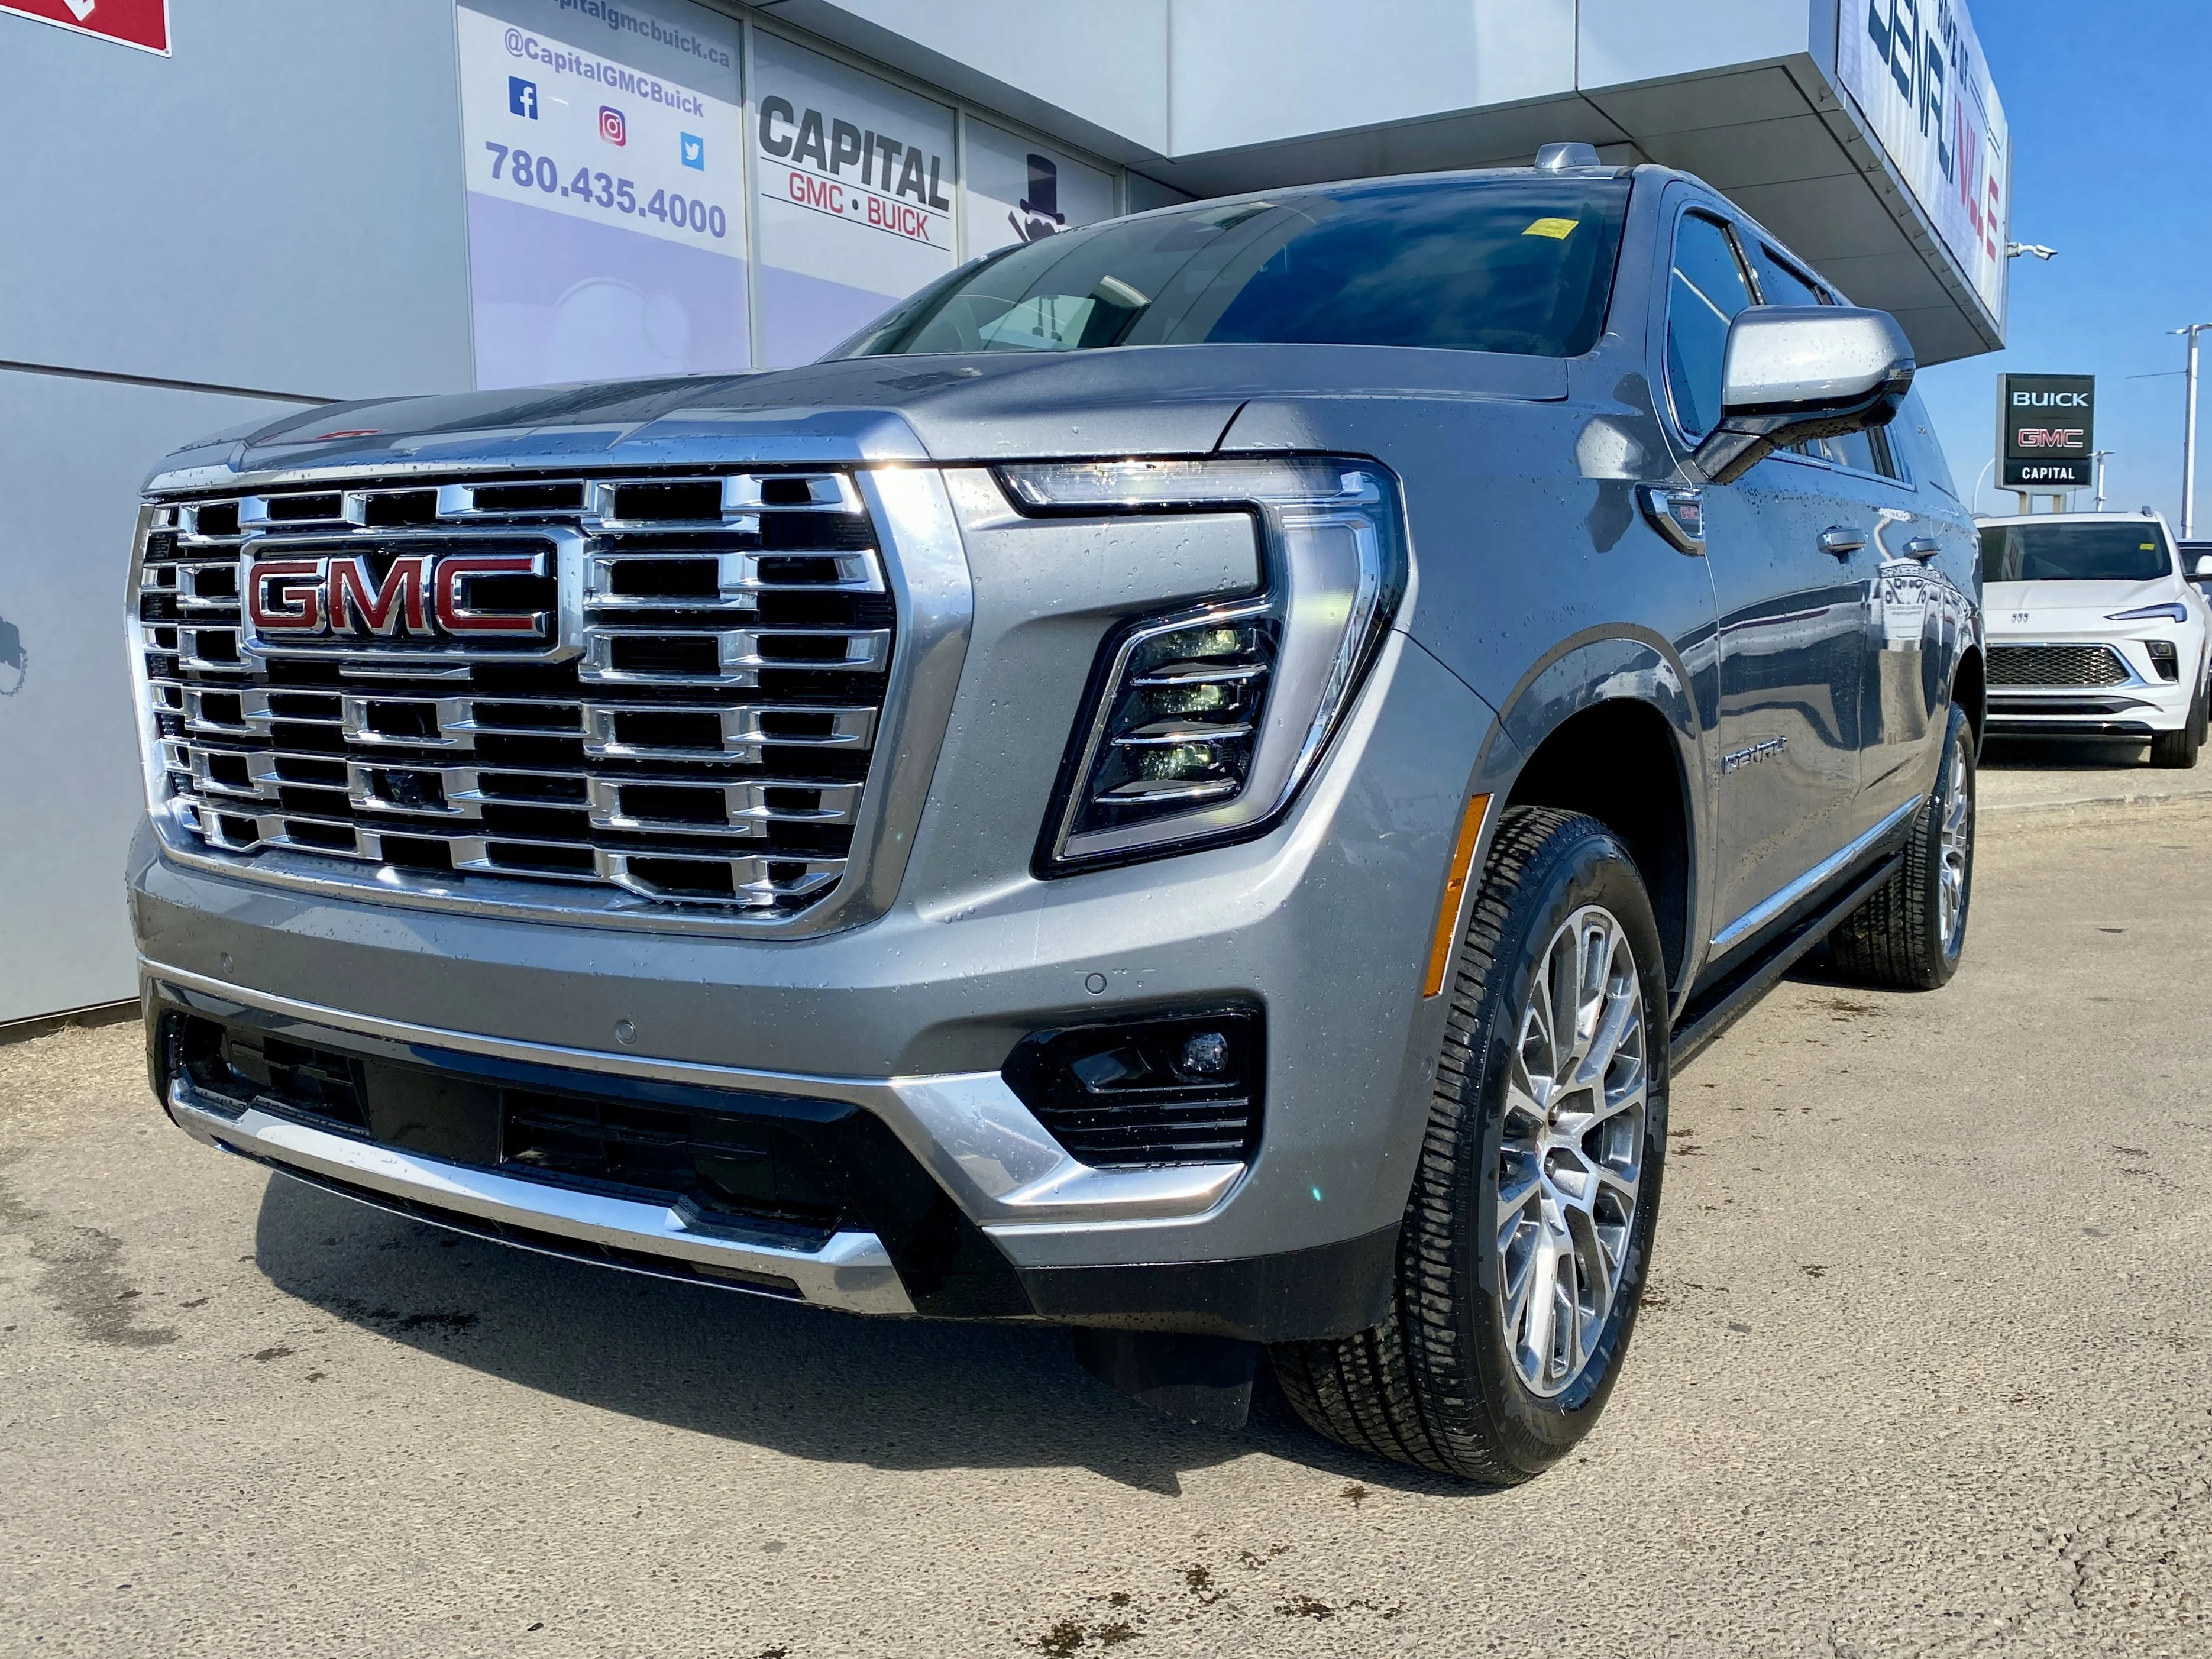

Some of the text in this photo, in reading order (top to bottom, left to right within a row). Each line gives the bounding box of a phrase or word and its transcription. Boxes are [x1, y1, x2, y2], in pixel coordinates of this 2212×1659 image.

[505, 28, 704, 117] @CapitalGMCBuick
[759, 95, 950, 212] CAPITAL
[485, 141, 726, 238] 780.435.4000
[788, 172, 930, 241] GMC BUICK
[2013, 392, 2090, 407] BUICK
[2017, 428, 2084, 448] GMC
[2022, 467, 2076, 480] CAPITAL
[1679, 506, 1699, 520] GMC
[248, 553, 549, 636] GMC
